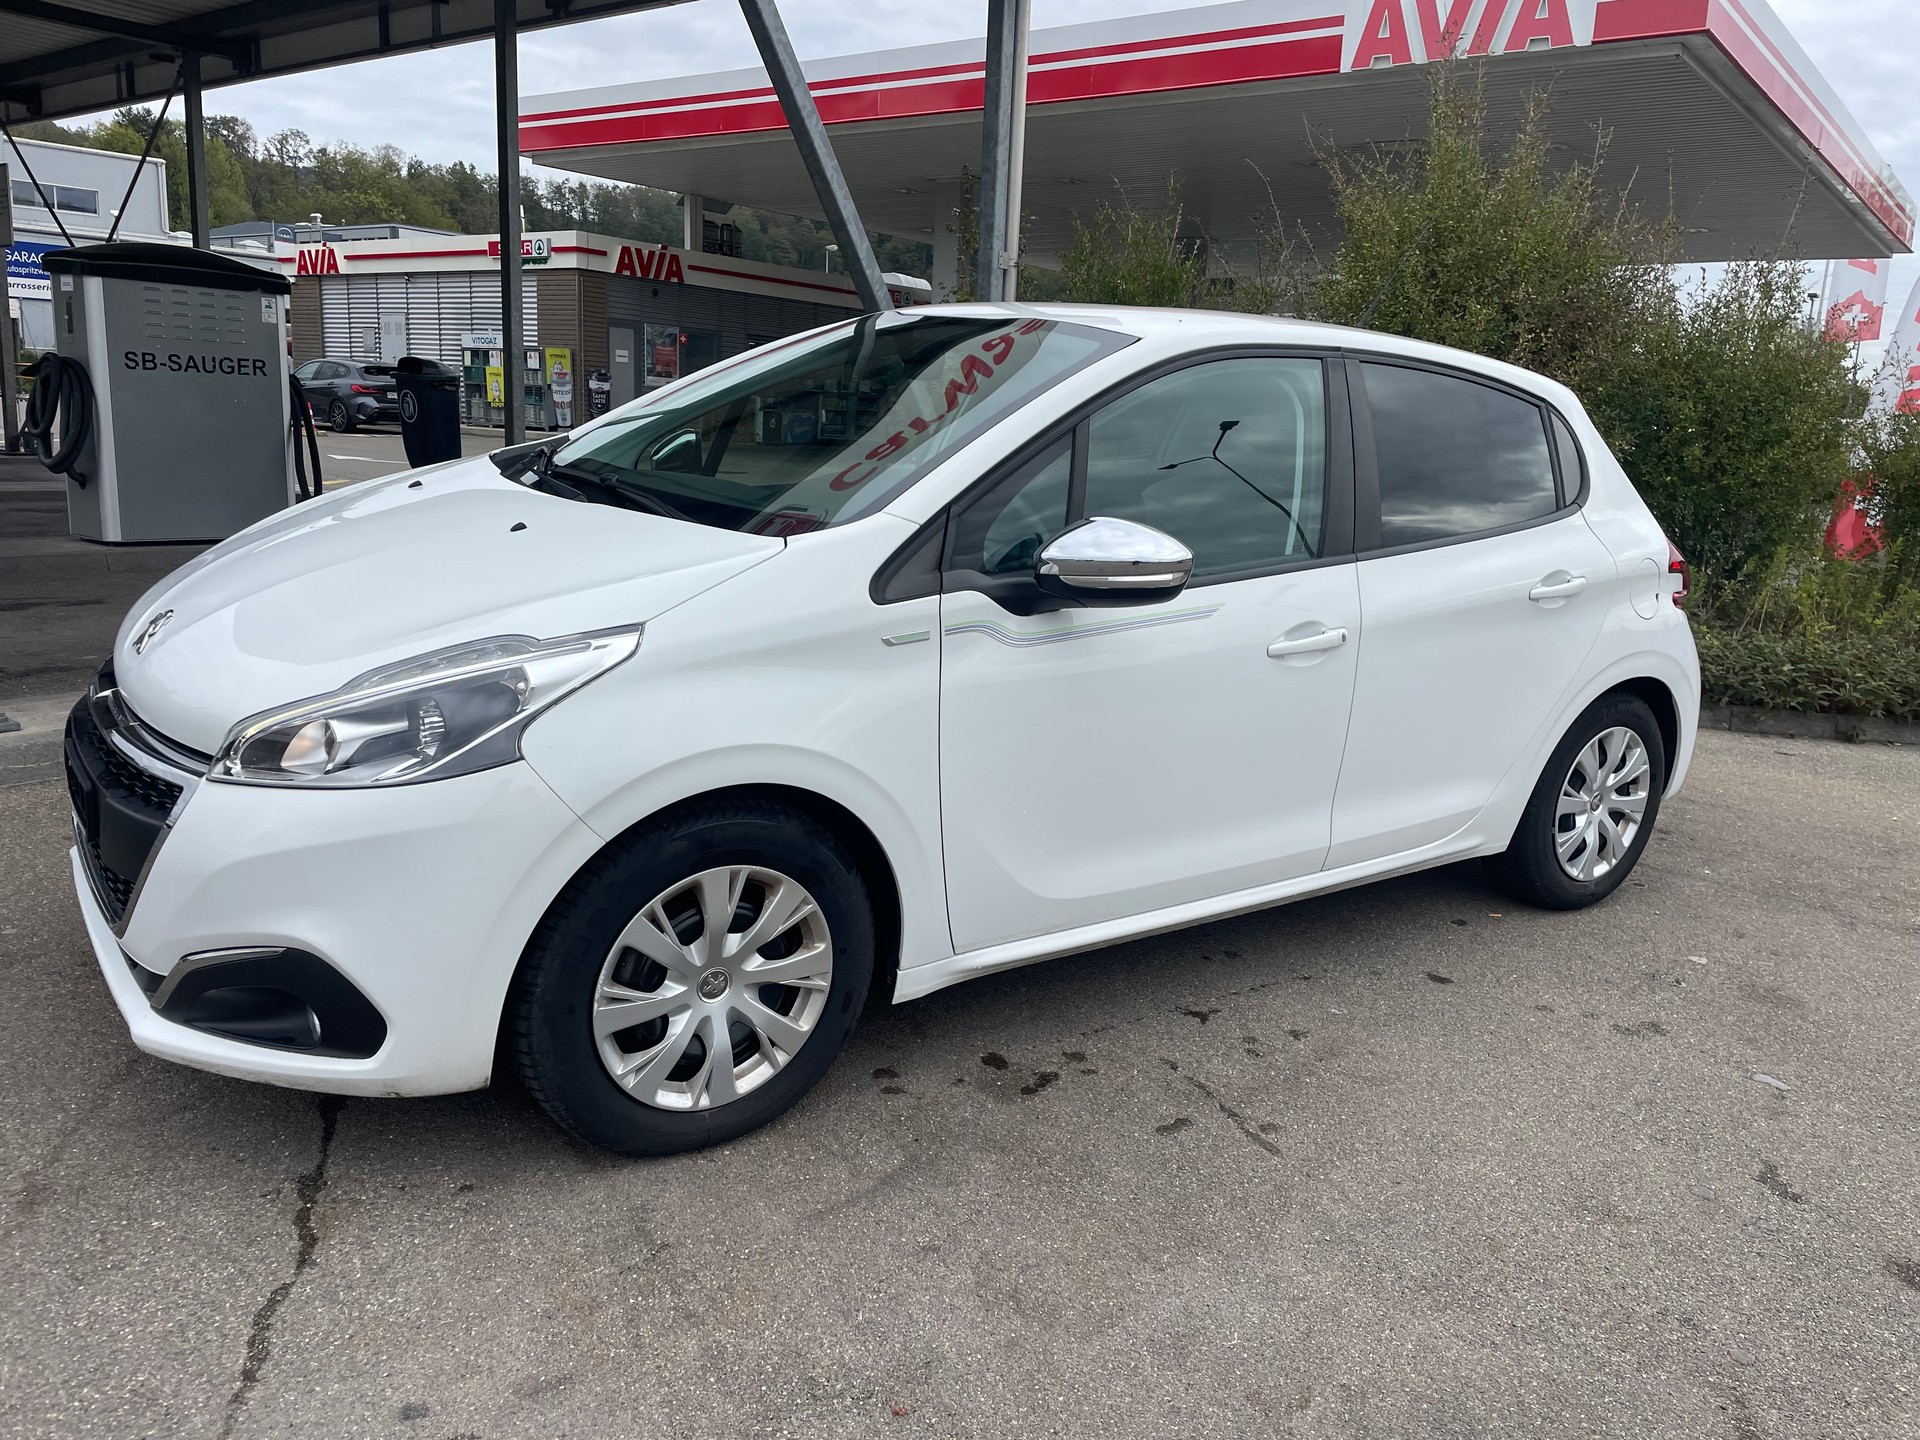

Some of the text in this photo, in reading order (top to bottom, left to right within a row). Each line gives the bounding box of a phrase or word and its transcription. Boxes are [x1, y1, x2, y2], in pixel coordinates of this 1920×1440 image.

[1350, 0, 1577, 71] AVIA
[297, 241, 340, 275] AVIA
[615, 244, 685, 285] AVIA
[8, 281, 52, 291] arrosseri
[471, 336, 498, 345] VITOGAZ
[123, 350, 268, 377] SB-SAUGER
